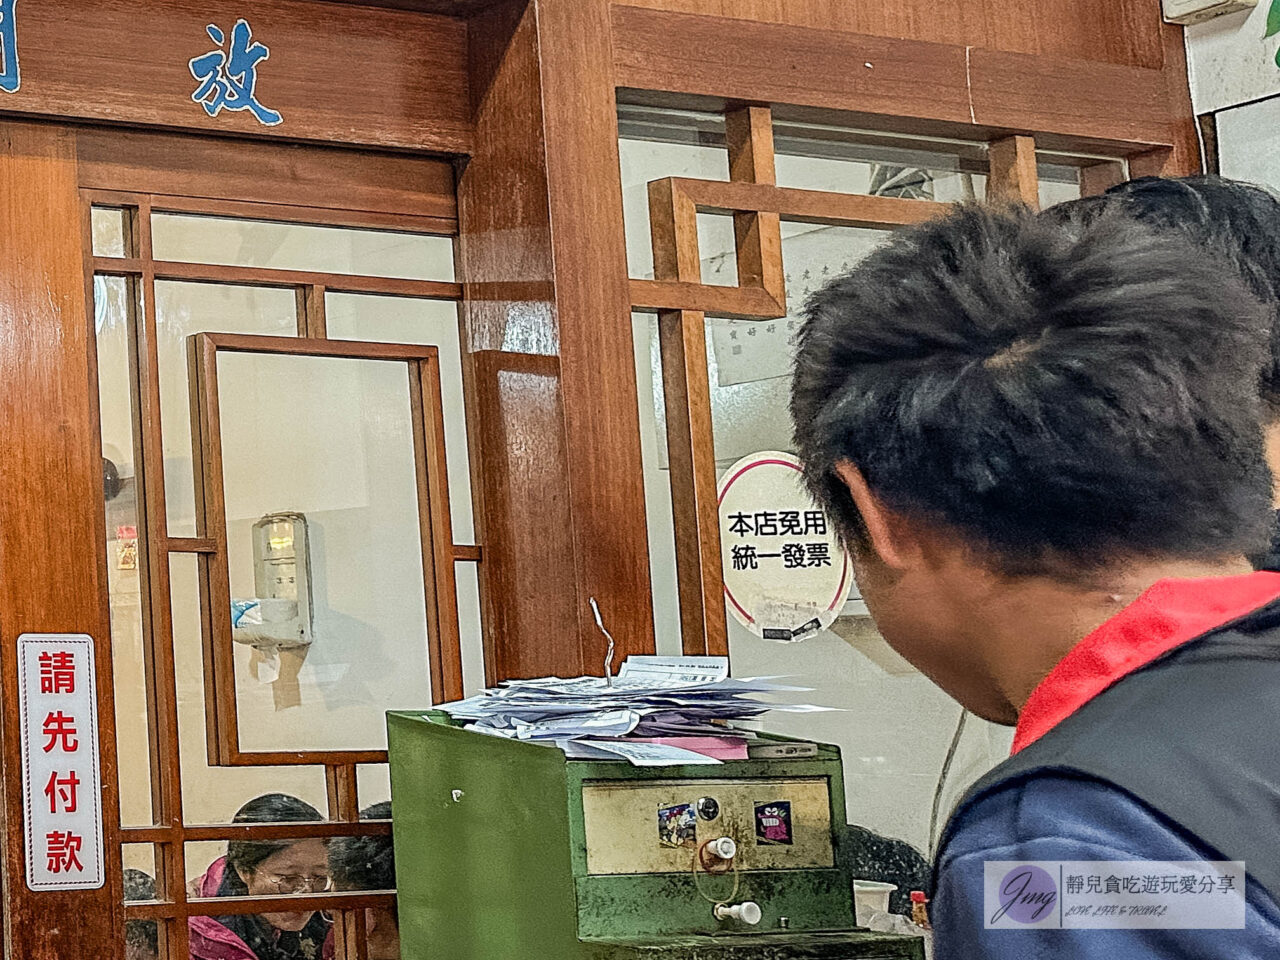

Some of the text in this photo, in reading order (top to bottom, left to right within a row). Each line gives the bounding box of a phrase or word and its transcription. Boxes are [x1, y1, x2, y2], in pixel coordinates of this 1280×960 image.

[727, 510, 828, 538] 本店免用
[730, 542, 832, 571] 統一發票
[37, 650, 85, 875] 請先付款
